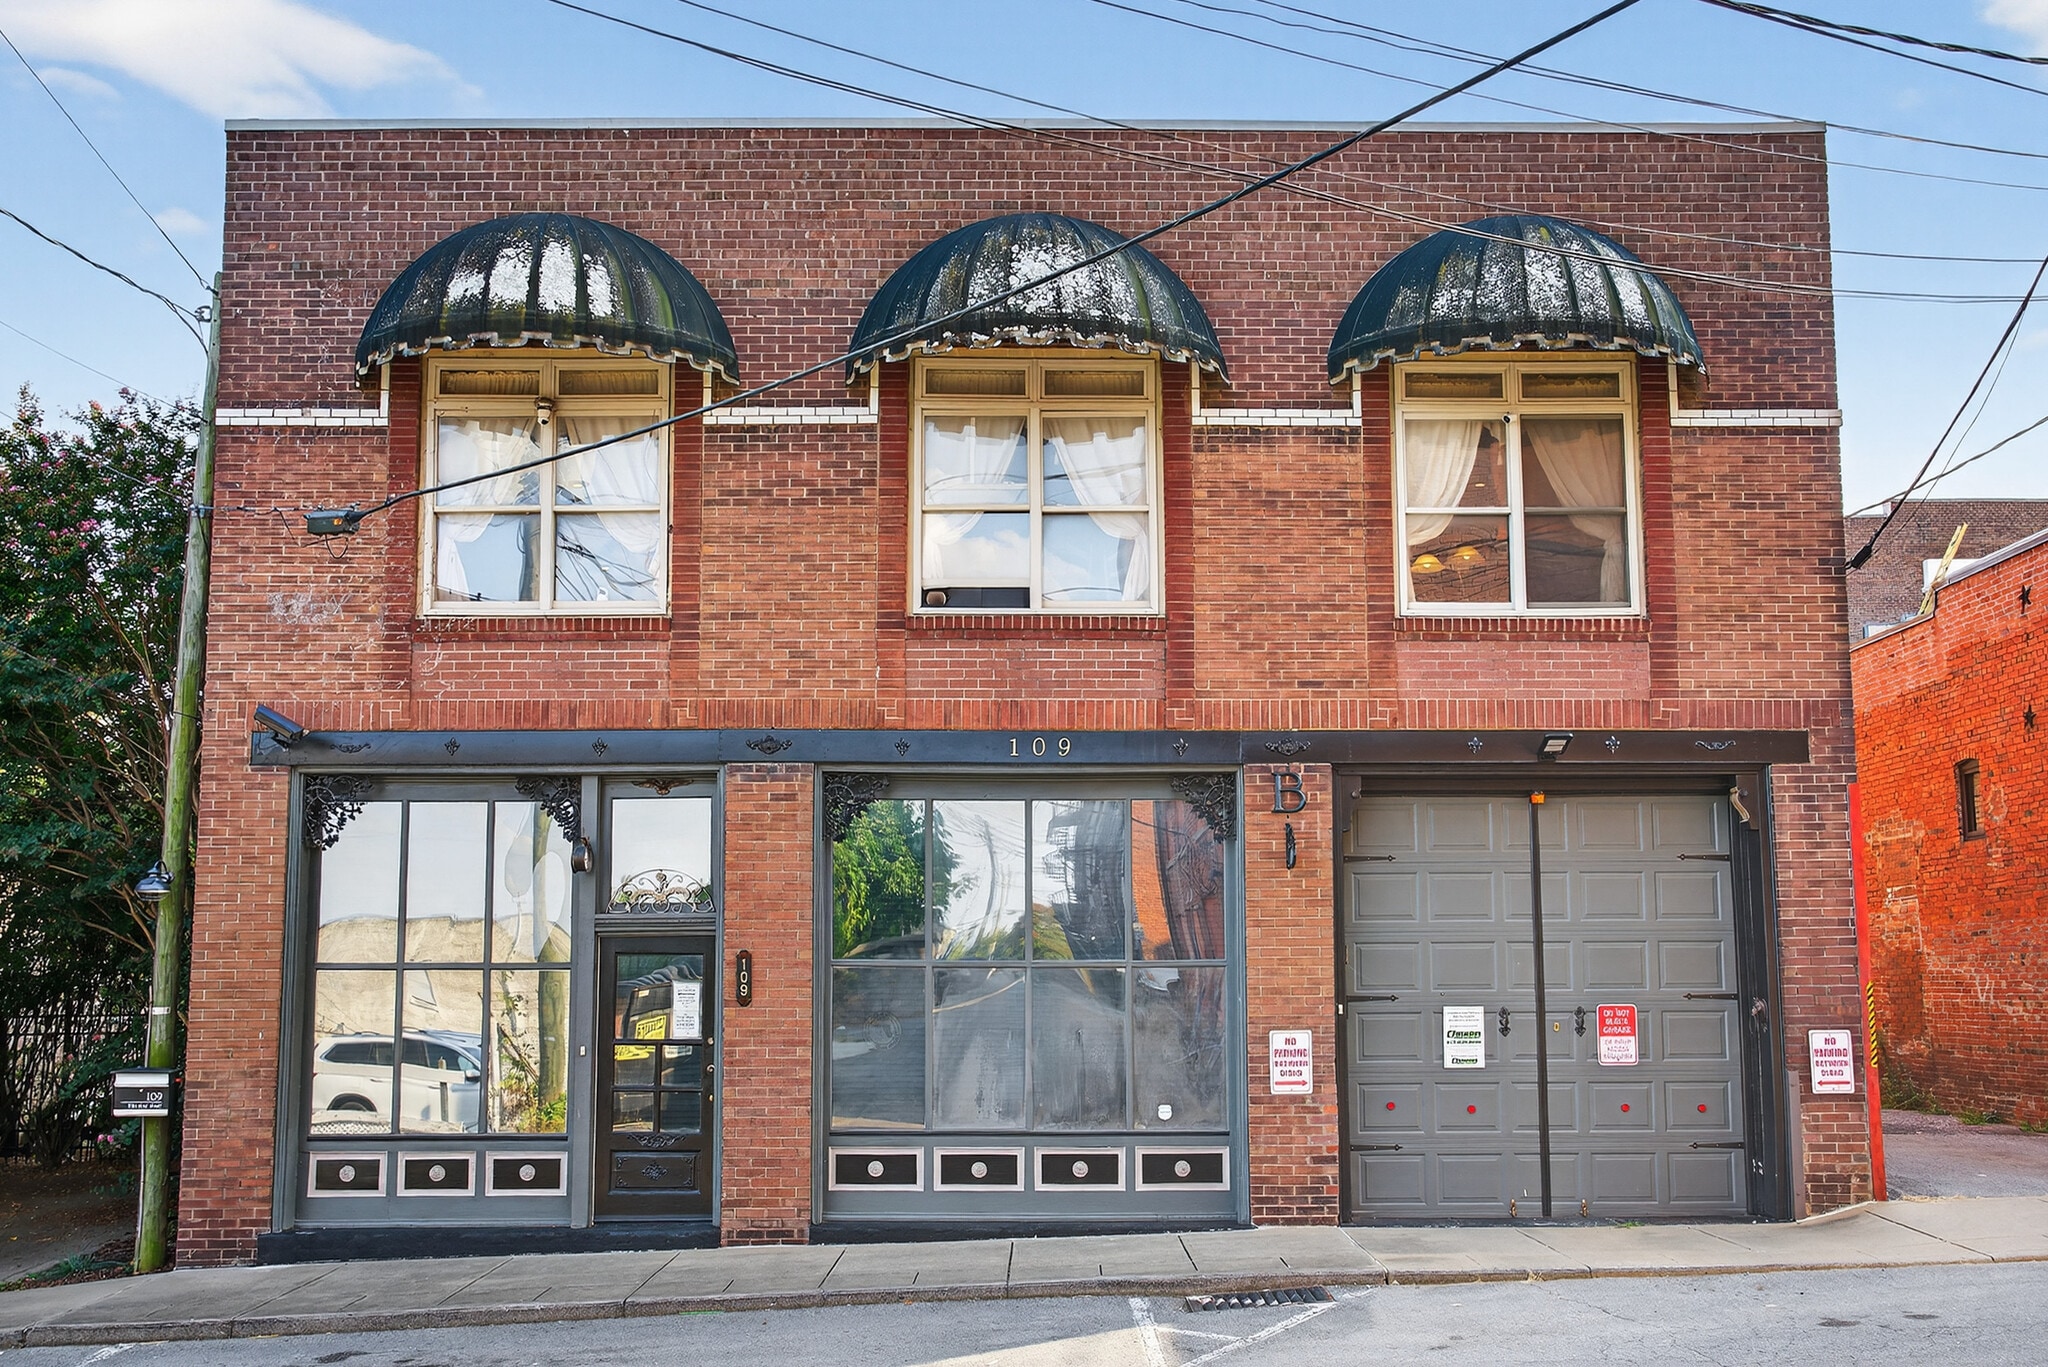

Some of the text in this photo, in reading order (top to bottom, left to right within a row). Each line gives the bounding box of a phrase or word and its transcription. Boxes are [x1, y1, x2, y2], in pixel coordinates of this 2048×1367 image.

[1009, 737, 1071, 757] 109
[1271, 772, 1306, 813] B
[740, 958, 748, 996] 109
[1284, 1037, 1297, 1046] NO
[1824, 1037, 1837, 1046] NO
[146, 1091, 163, 1101] 109
